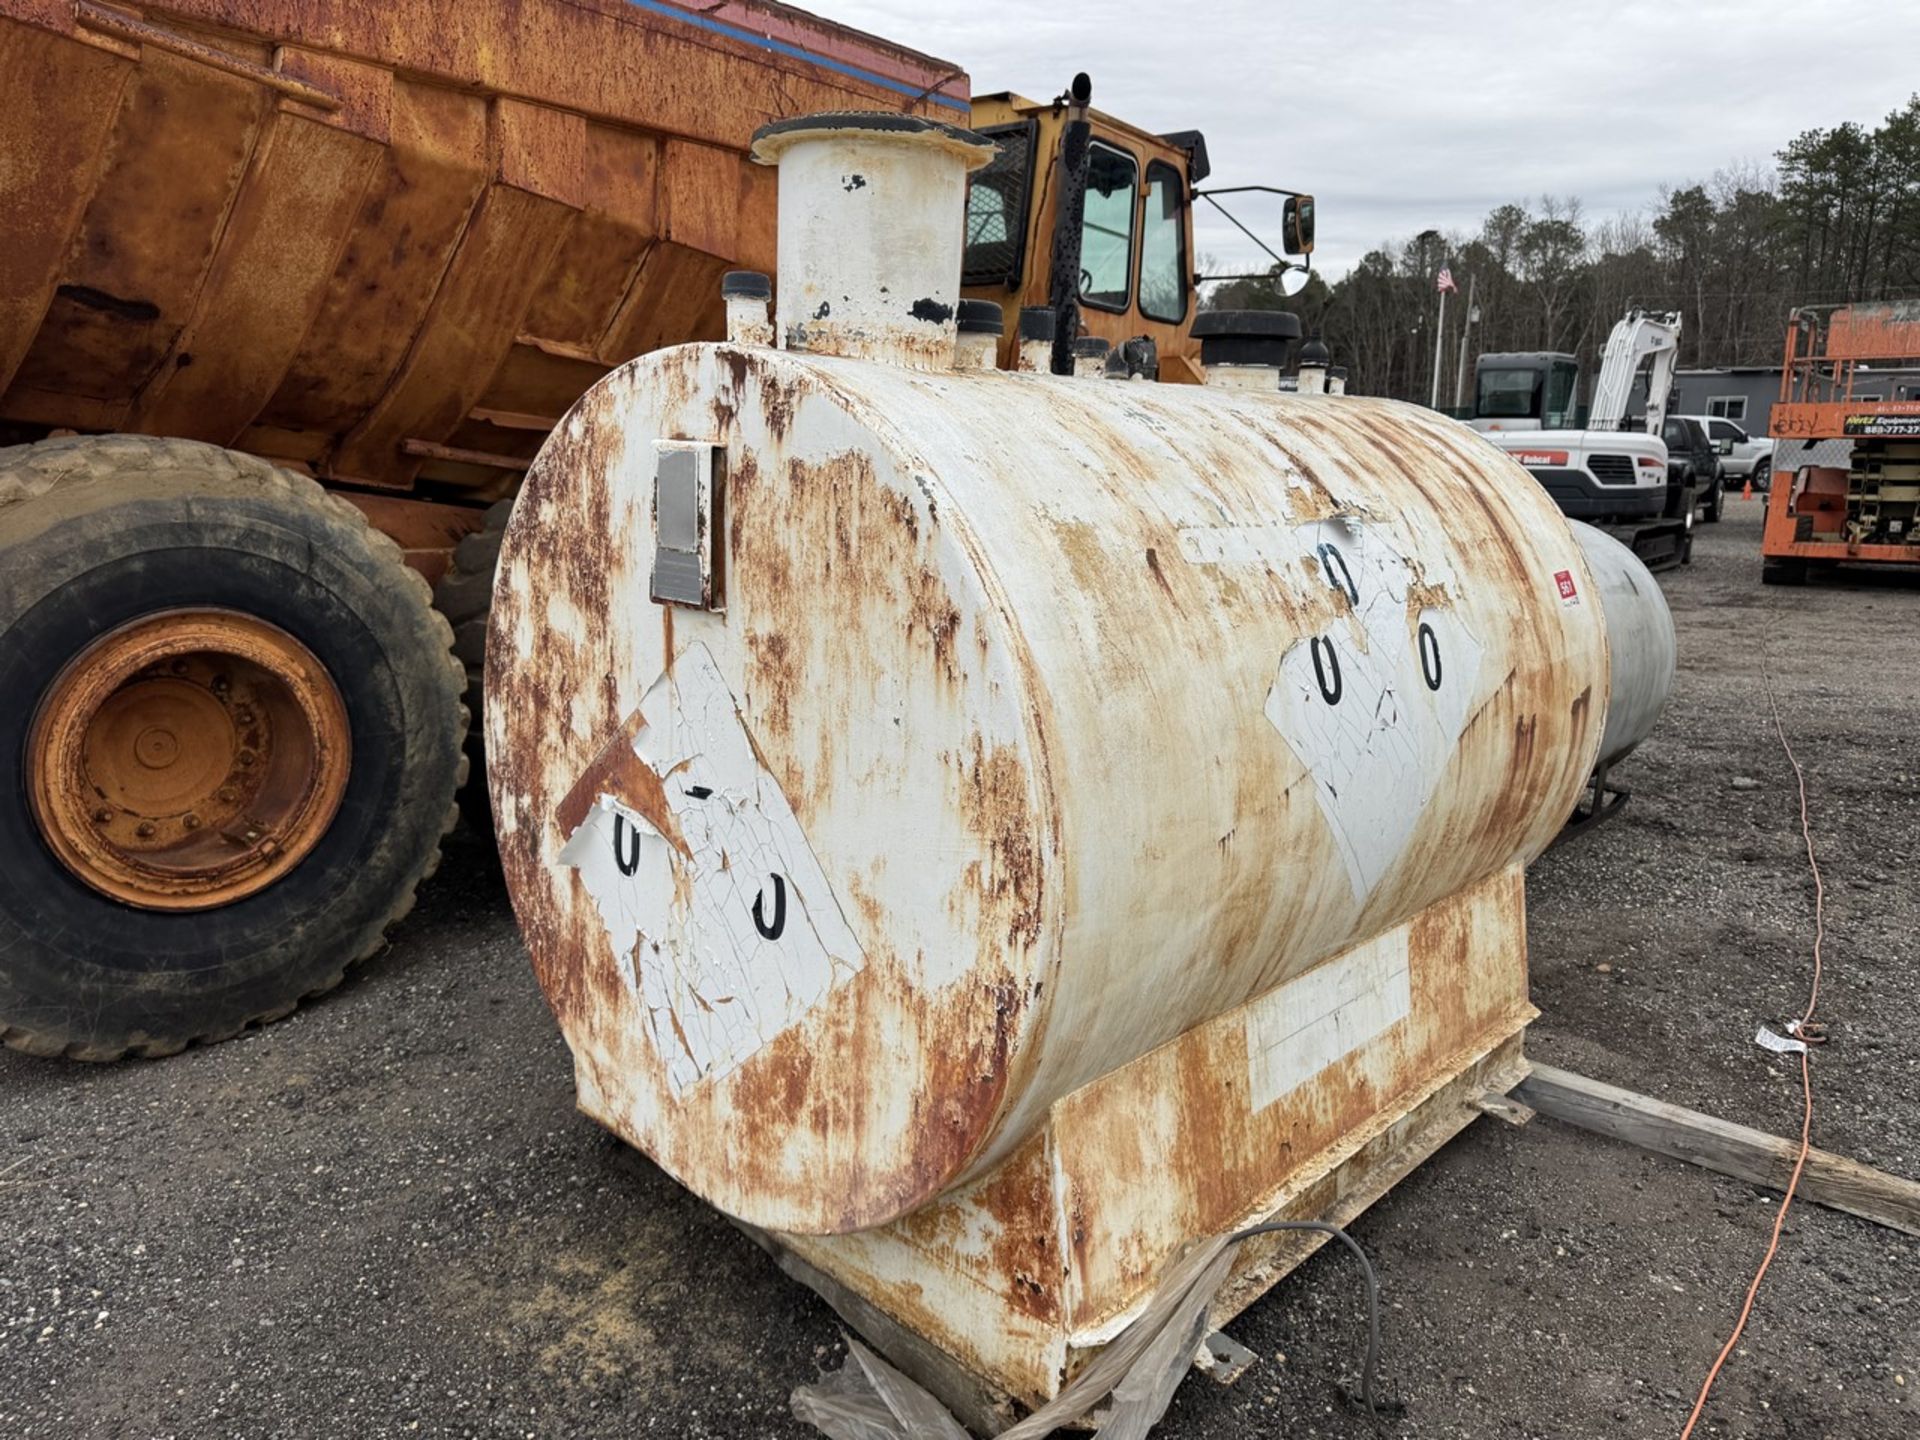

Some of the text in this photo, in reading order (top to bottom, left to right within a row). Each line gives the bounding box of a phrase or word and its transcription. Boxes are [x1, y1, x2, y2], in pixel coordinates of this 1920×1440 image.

[1846, 416, 1920, 426] Hertz Equipmen
[1864, 425, 1920, 435] 888-777-27
[1523, 454, 1551, 465] Bobcat
